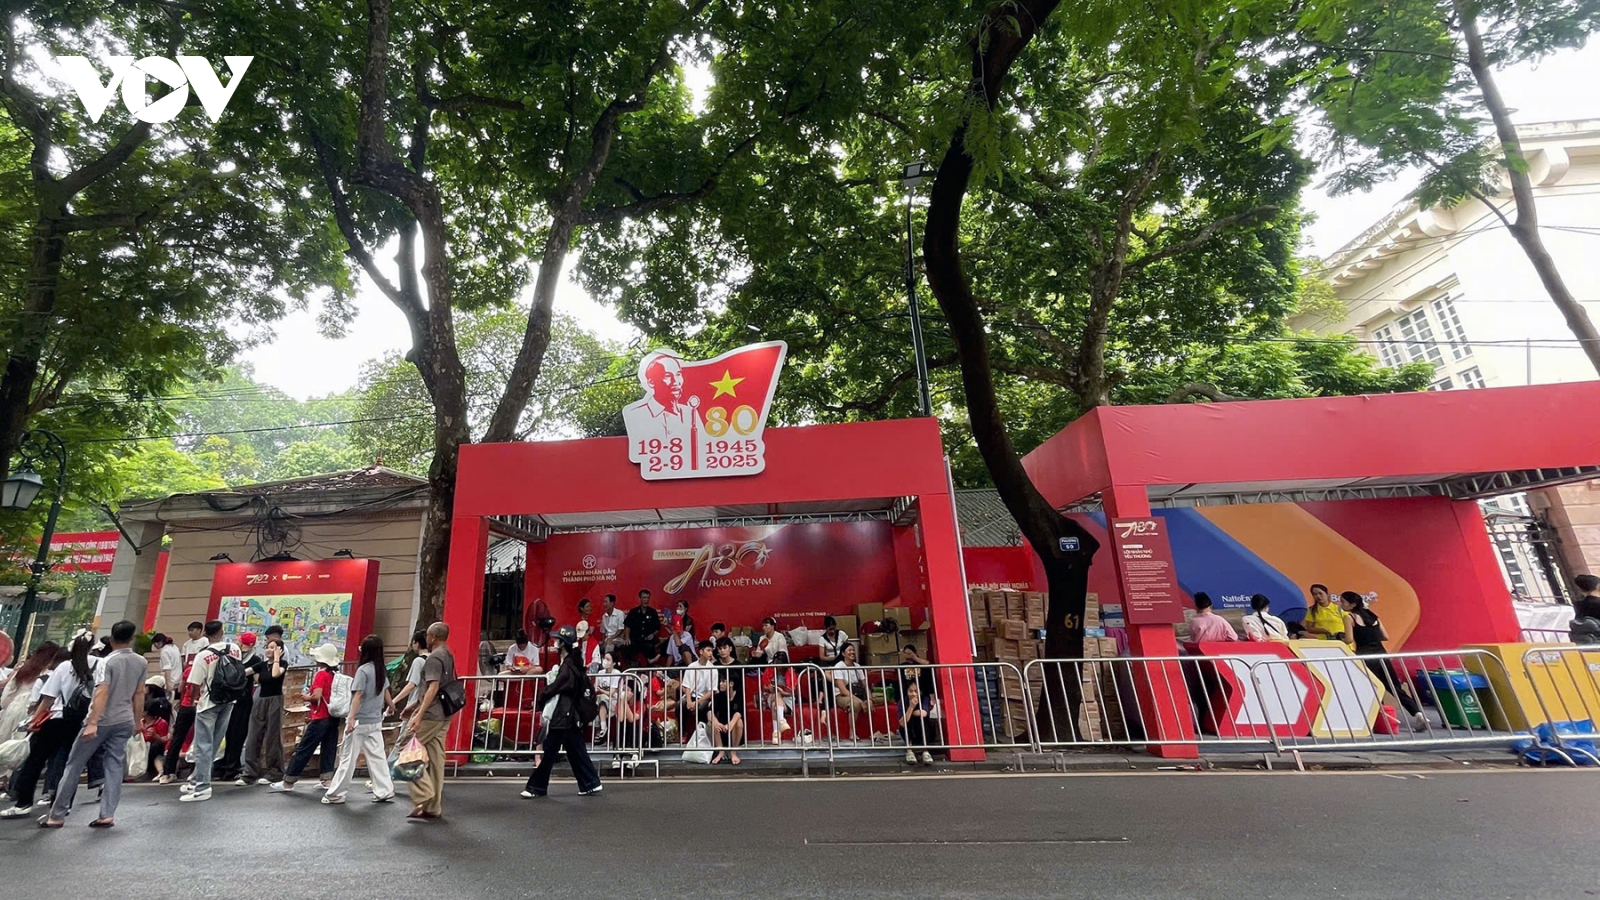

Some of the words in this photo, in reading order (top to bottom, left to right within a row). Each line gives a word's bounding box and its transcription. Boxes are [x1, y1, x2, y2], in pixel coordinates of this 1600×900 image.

[704, 405, 759, 437] 80
[638, 438, 683, 455] 19-8
[705, 440, 757, 454] 1945
[649, 455, 683, 472] 2-9
[706, 454, 758, 469] 2025
[664, 542, 773, 594] A80
[713, 578, 731, 587] HÀO
[733, 577, 750, 586] VIỆT
[1065, 614, 1079, 629] 61
